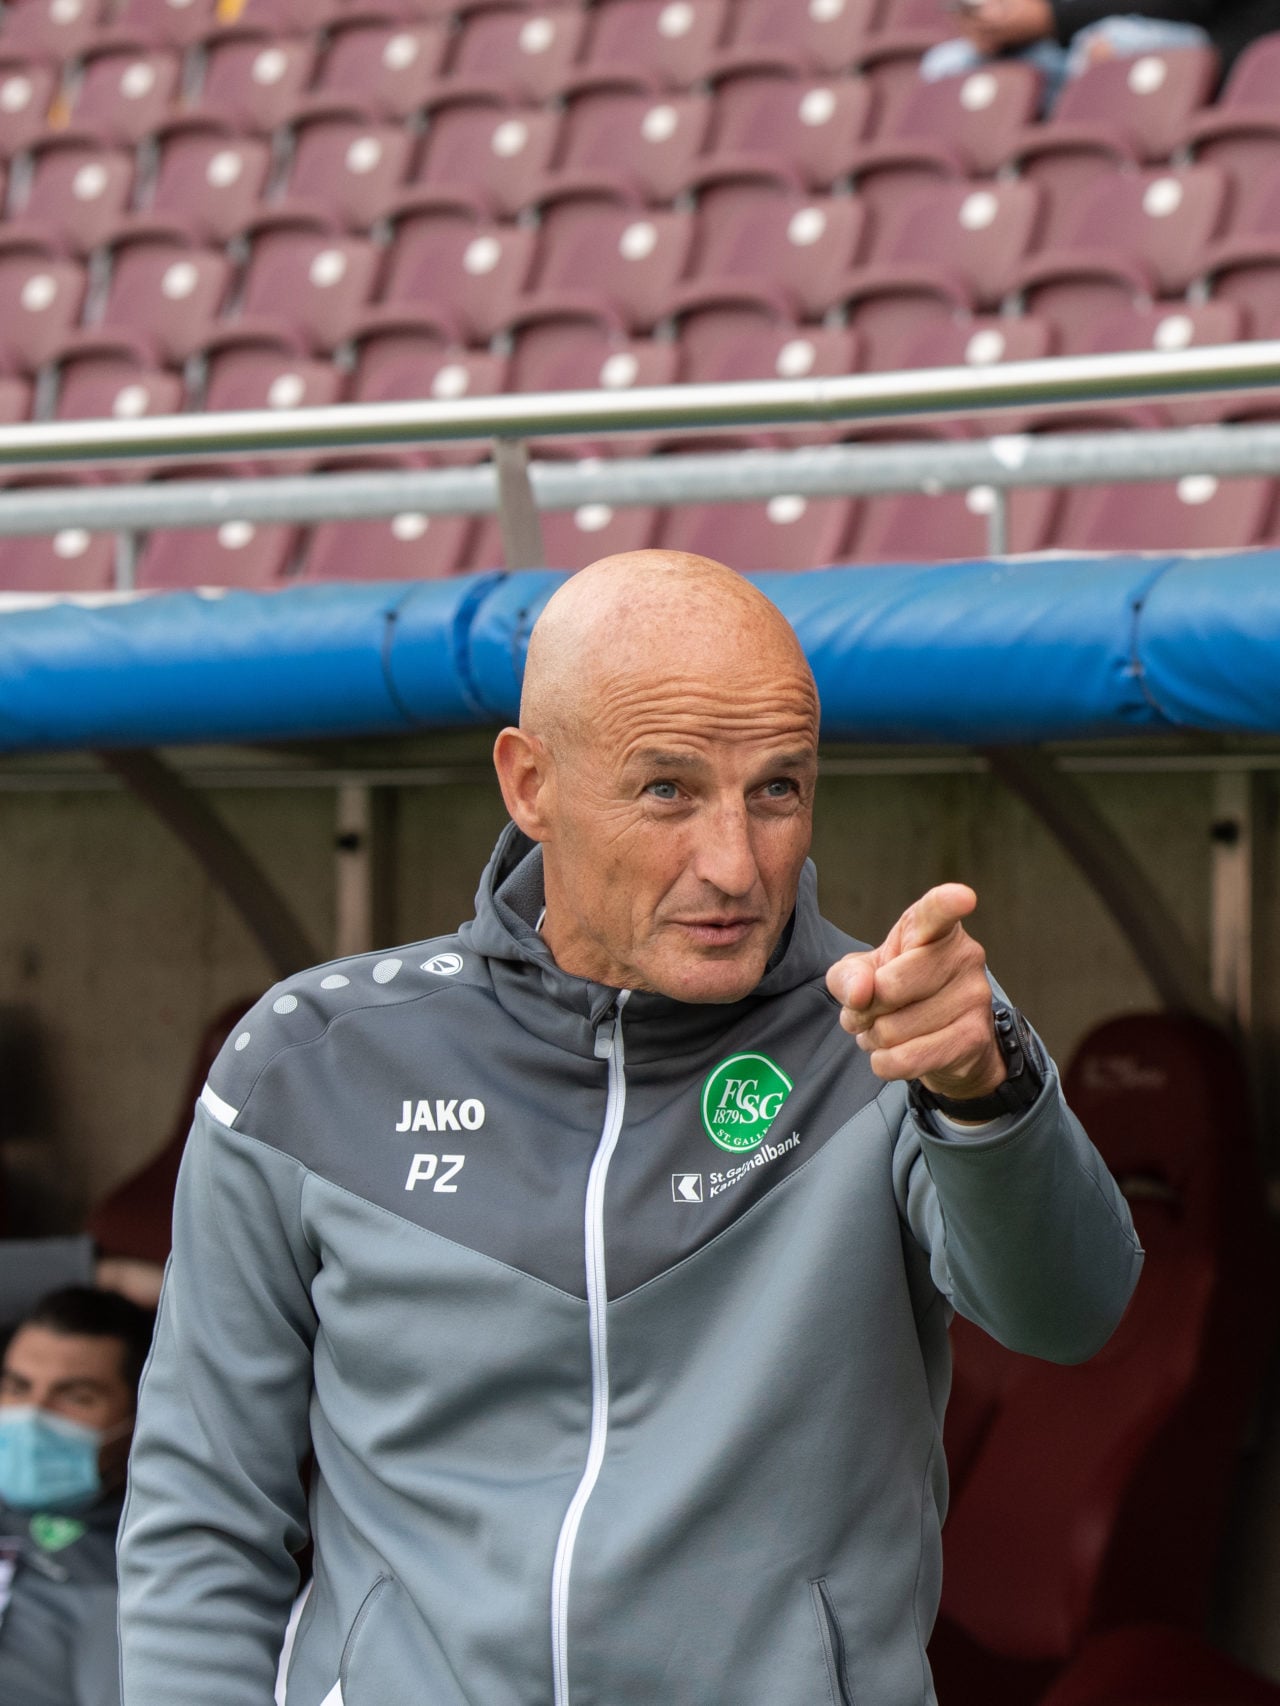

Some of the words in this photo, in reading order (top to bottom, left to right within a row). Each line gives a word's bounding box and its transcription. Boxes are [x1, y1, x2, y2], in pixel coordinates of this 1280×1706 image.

[395, 1098, 485, 1132] JAKO
[711, 1108, 740, 1125] 1879
[404, 1153, 465, 1193] PZ
[709, 1171, 727, 1186] St.
